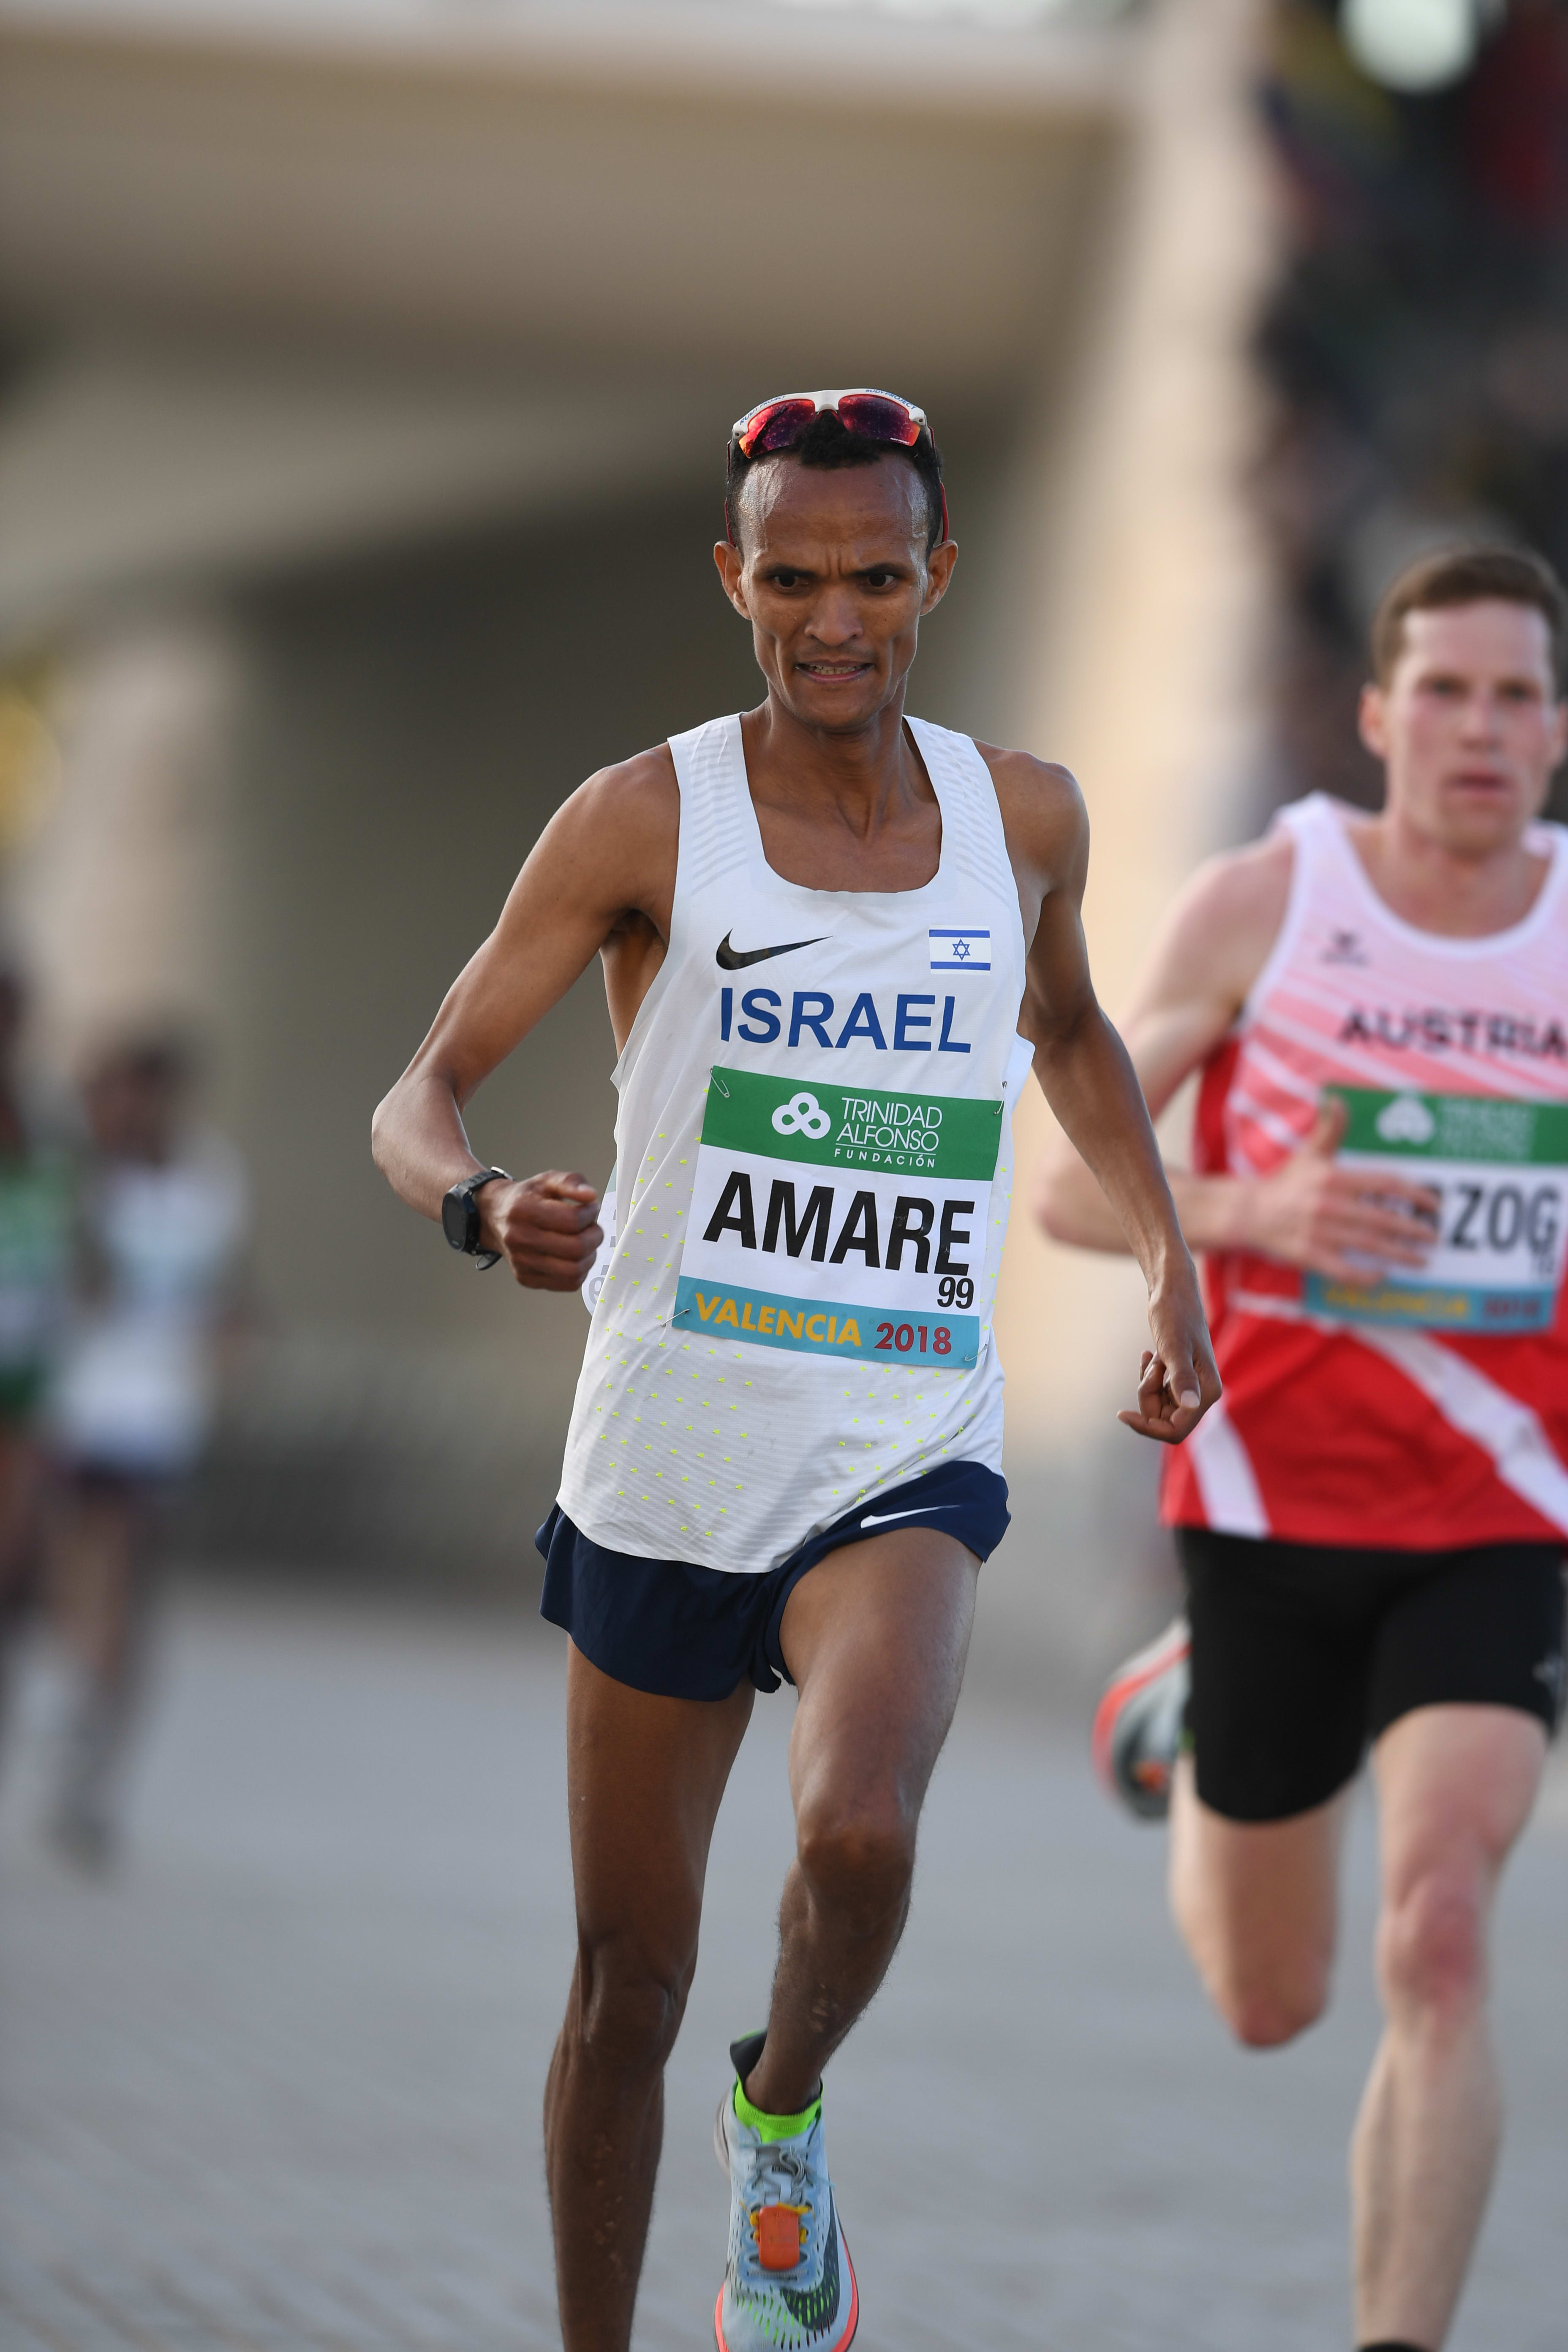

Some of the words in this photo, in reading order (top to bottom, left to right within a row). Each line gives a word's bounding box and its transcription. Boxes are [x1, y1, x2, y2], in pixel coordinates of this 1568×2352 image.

[885, 392, 917, 409] PROJECT
[721, 988, 971, 1053] ISRAEL
[1339, 1006, 1568, 1061] AUSTRIA
[841, 1097, 943, 1129] TRINIDAD
[836, 1122, 939, 1152] ALFONSO
[834, 1148, 935, 1168] FUNDACIÓN
[702, 1171, 975, 1276] AMARE
[937, 1277, 974, 1309] 99
[695, 1293, 862, 1347] VALENCIA
[874, 1322, 952, 1355] 2018
